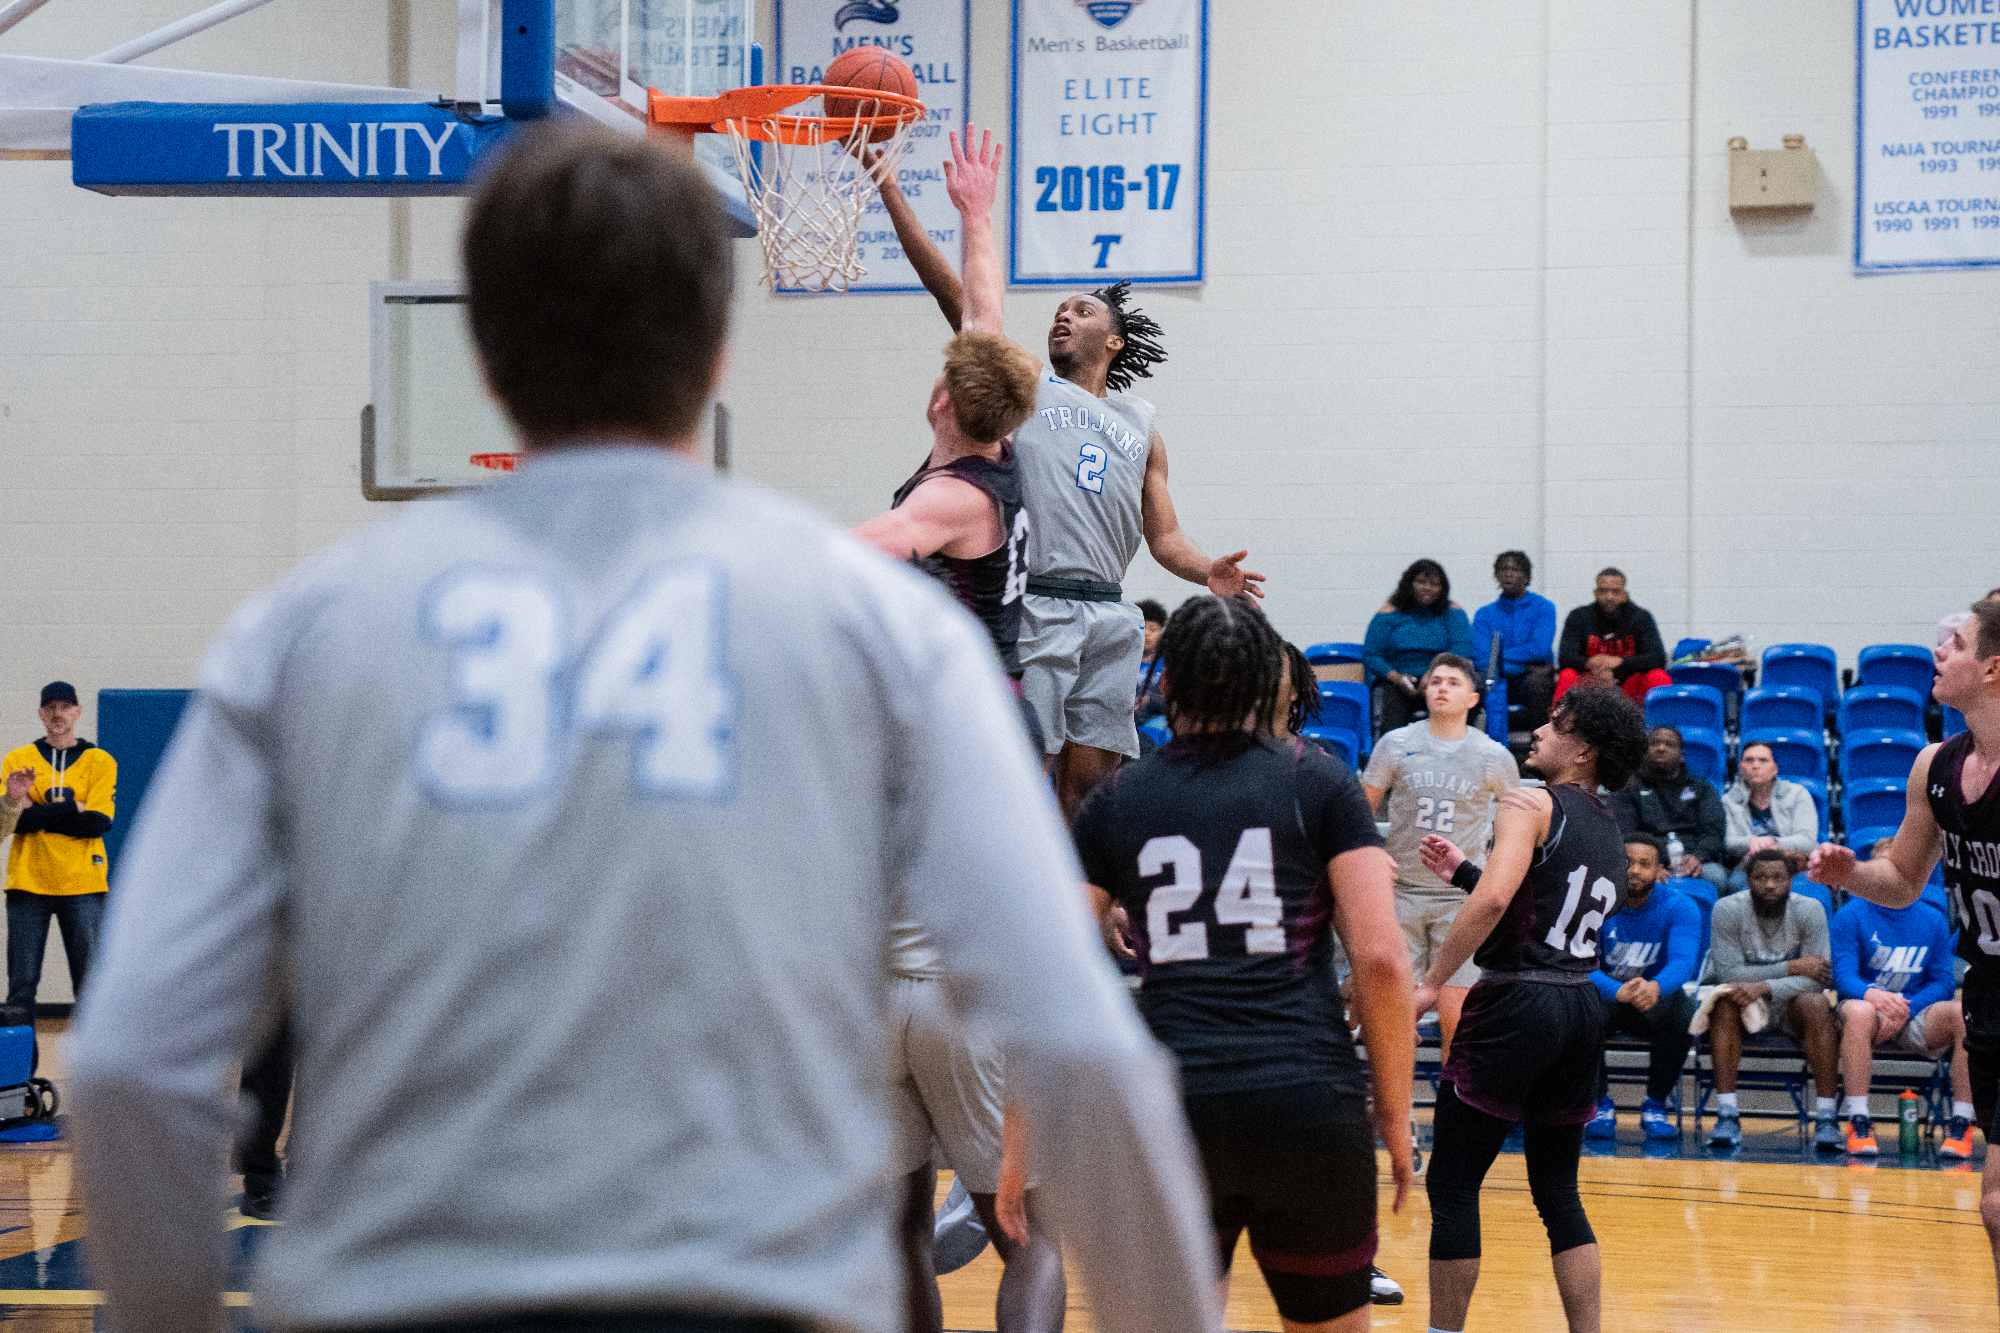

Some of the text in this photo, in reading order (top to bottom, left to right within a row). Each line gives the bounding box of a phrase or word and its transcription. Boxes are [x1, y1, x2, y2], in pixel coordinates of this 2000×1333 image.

[1894, 0, 2000, 18] WOME
[1027, 35, 1190, 52] Men's Basketball
[1065, 78, 1152, 100] ELITE
[1912, 84, 2000, 102] CHAMPIO
[1061, 112, 1157, 135] EIGHT
[213, 122, 458, 177] TRINITY
[1882, 142, 1926, 157] NAIA
[1919, 158, 1958, 173] 1993
[1036, 164, 1180, 212] 2016-17
[1874, 198, 2000, 215] USCAA TOURN
[1092, 235, 1122, 268] T
[1040, 405, 1146, 463] TROJANS
[1076, 443, 1108, 495] 2
[416, 562, 742, 810] 34
[1403, 771, 1481, 800] TROJANS
[1415, 795, 1456, 833] 22
[1137, 827, 1286, 964] 24
[1544, 864, 1617, 959] 12
